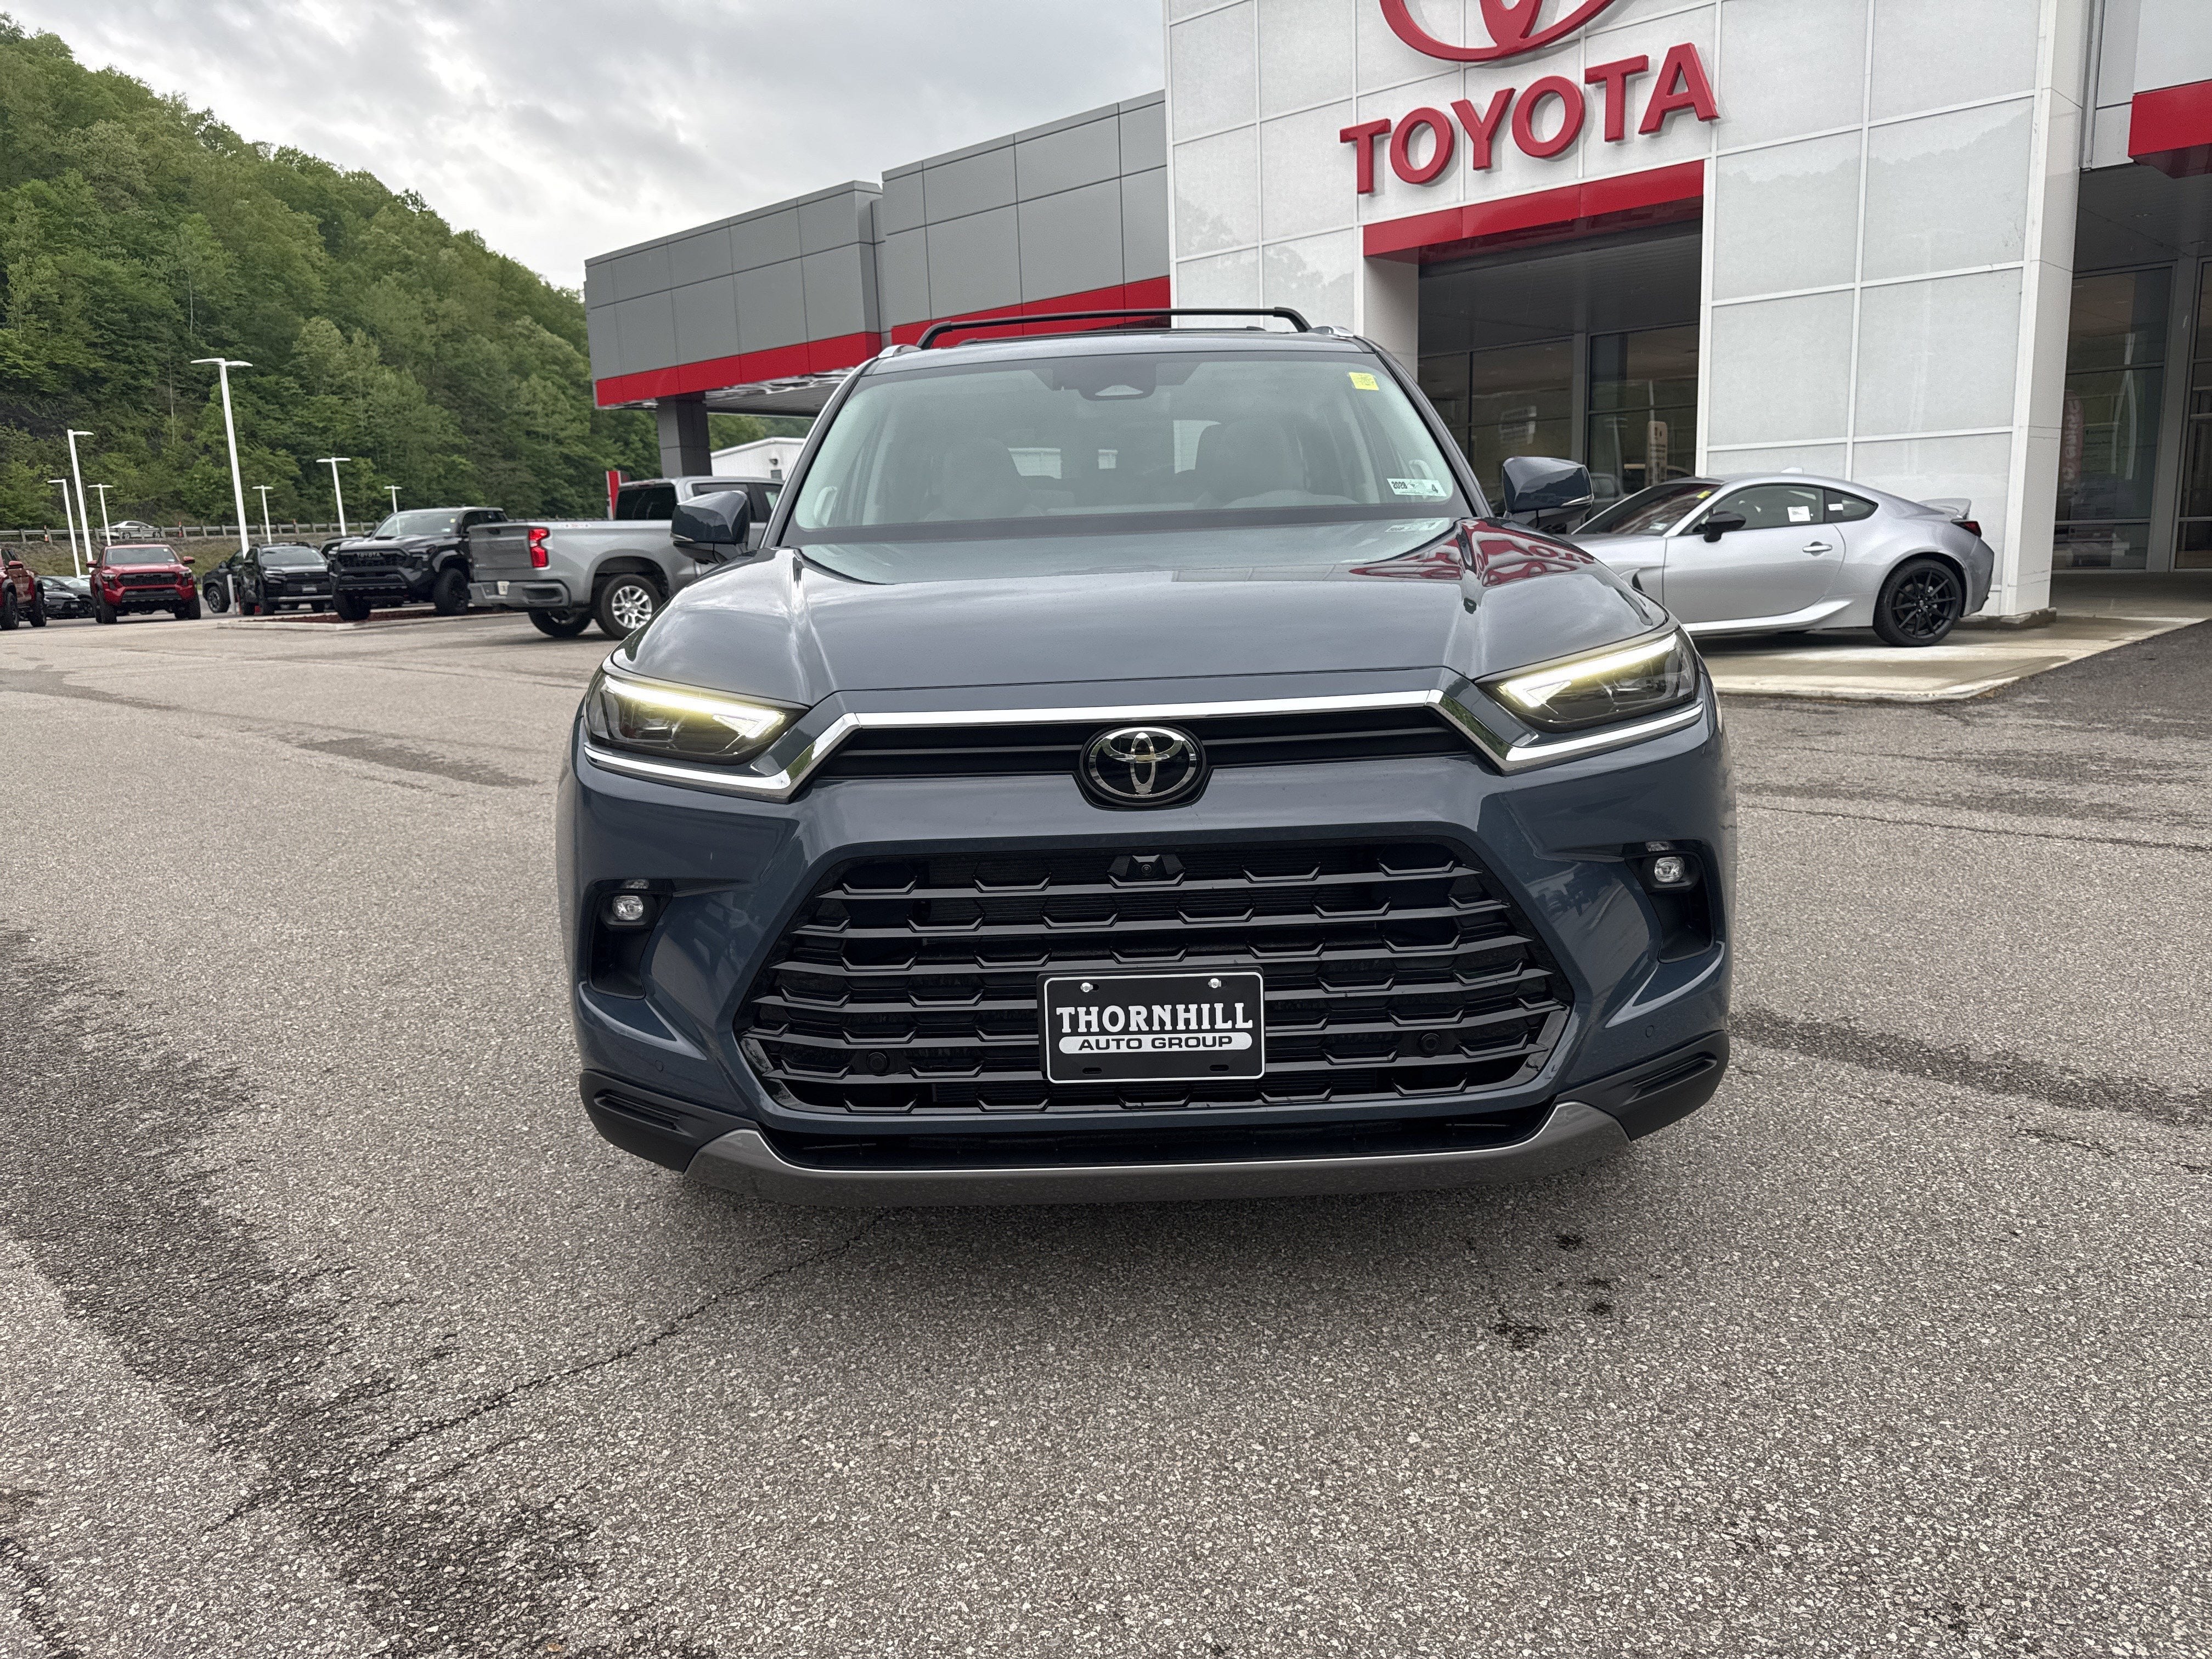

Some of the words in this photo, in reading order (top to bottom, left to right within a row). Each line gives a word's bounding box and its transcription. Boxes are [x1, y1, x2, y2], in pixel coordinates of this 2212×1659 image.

[1340, 42, 1720, 194] TOYOTA
[1056, 1002, 1253, 1033] THORNHILL
[1078, 1037, 1142, 1051] AUTO
[1150, 1035, 1233, 1049] GROUP
